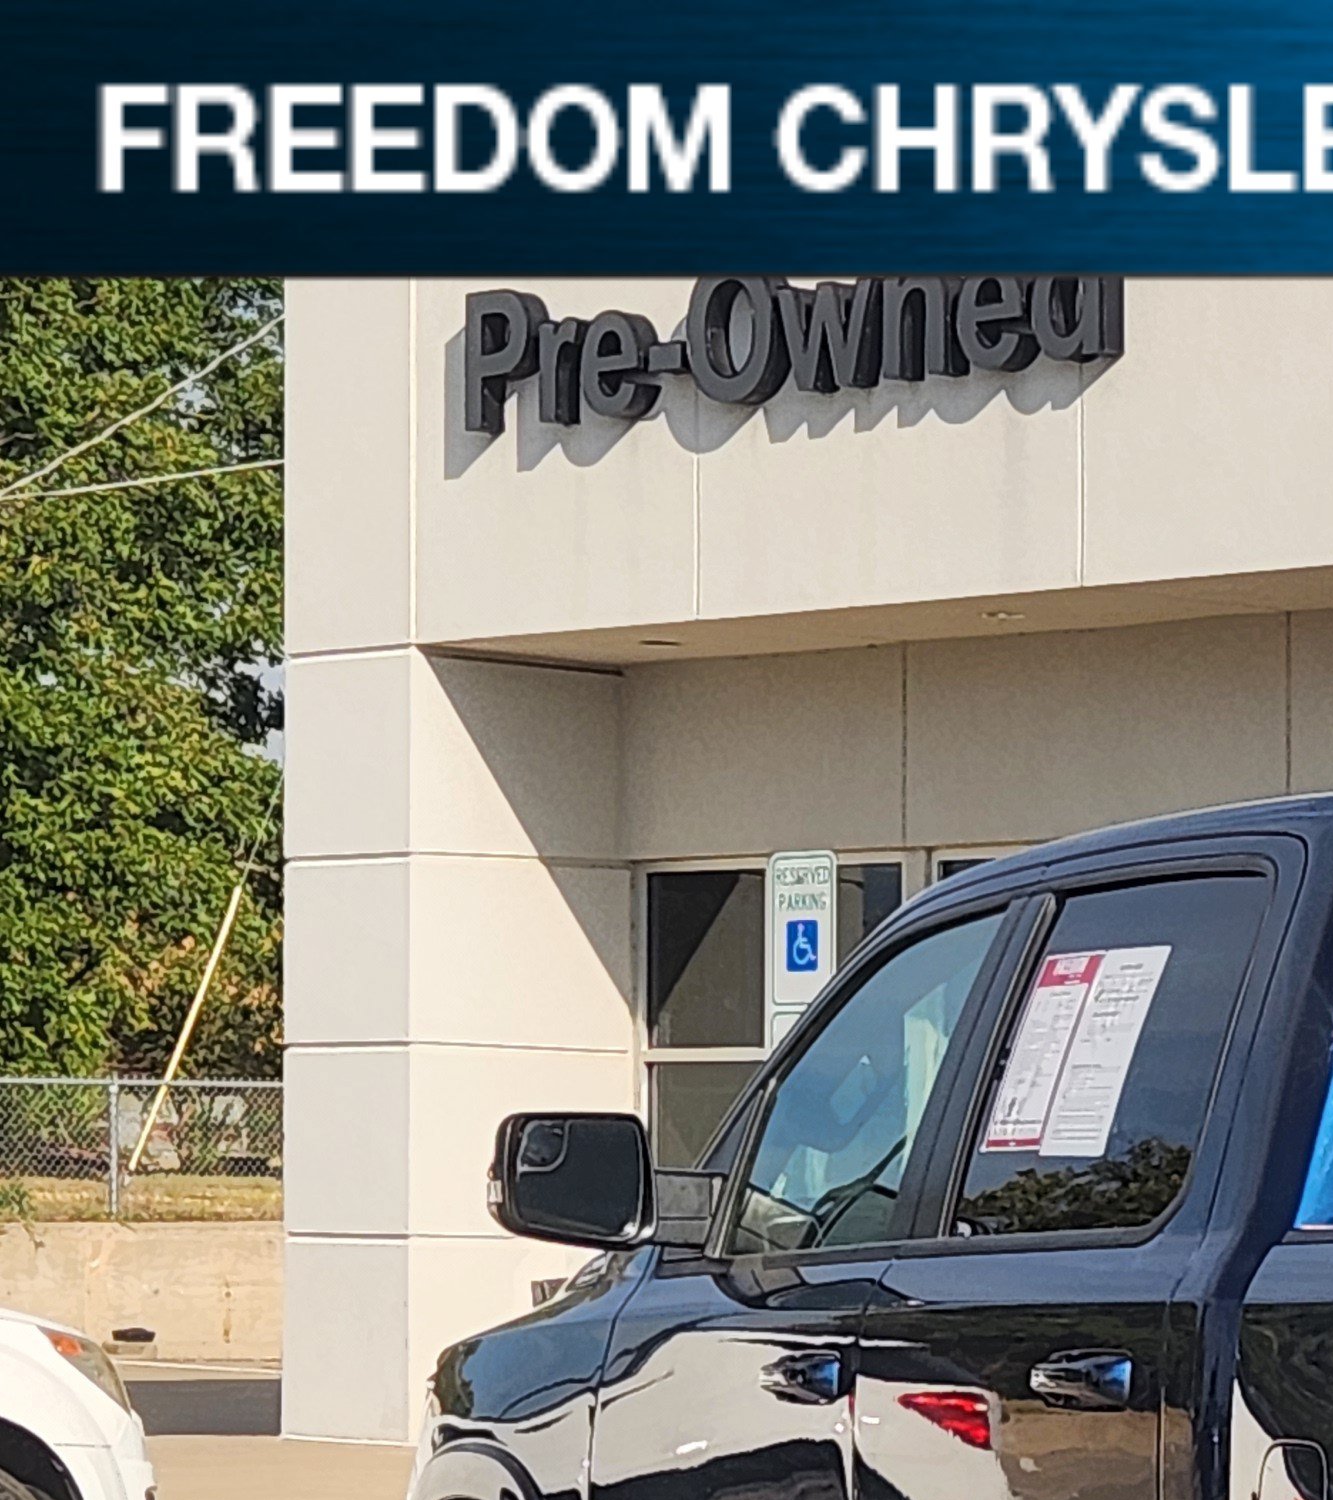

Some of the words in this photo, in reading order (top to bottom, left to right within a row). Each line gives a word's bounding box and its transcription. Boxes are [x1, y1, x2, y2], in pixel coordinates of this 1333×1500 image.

[465, 276, 1125, 437] Pre-Owned
[775, 865, 831, 887] RESERVED
[778, 891, 828, 912] PARKING
